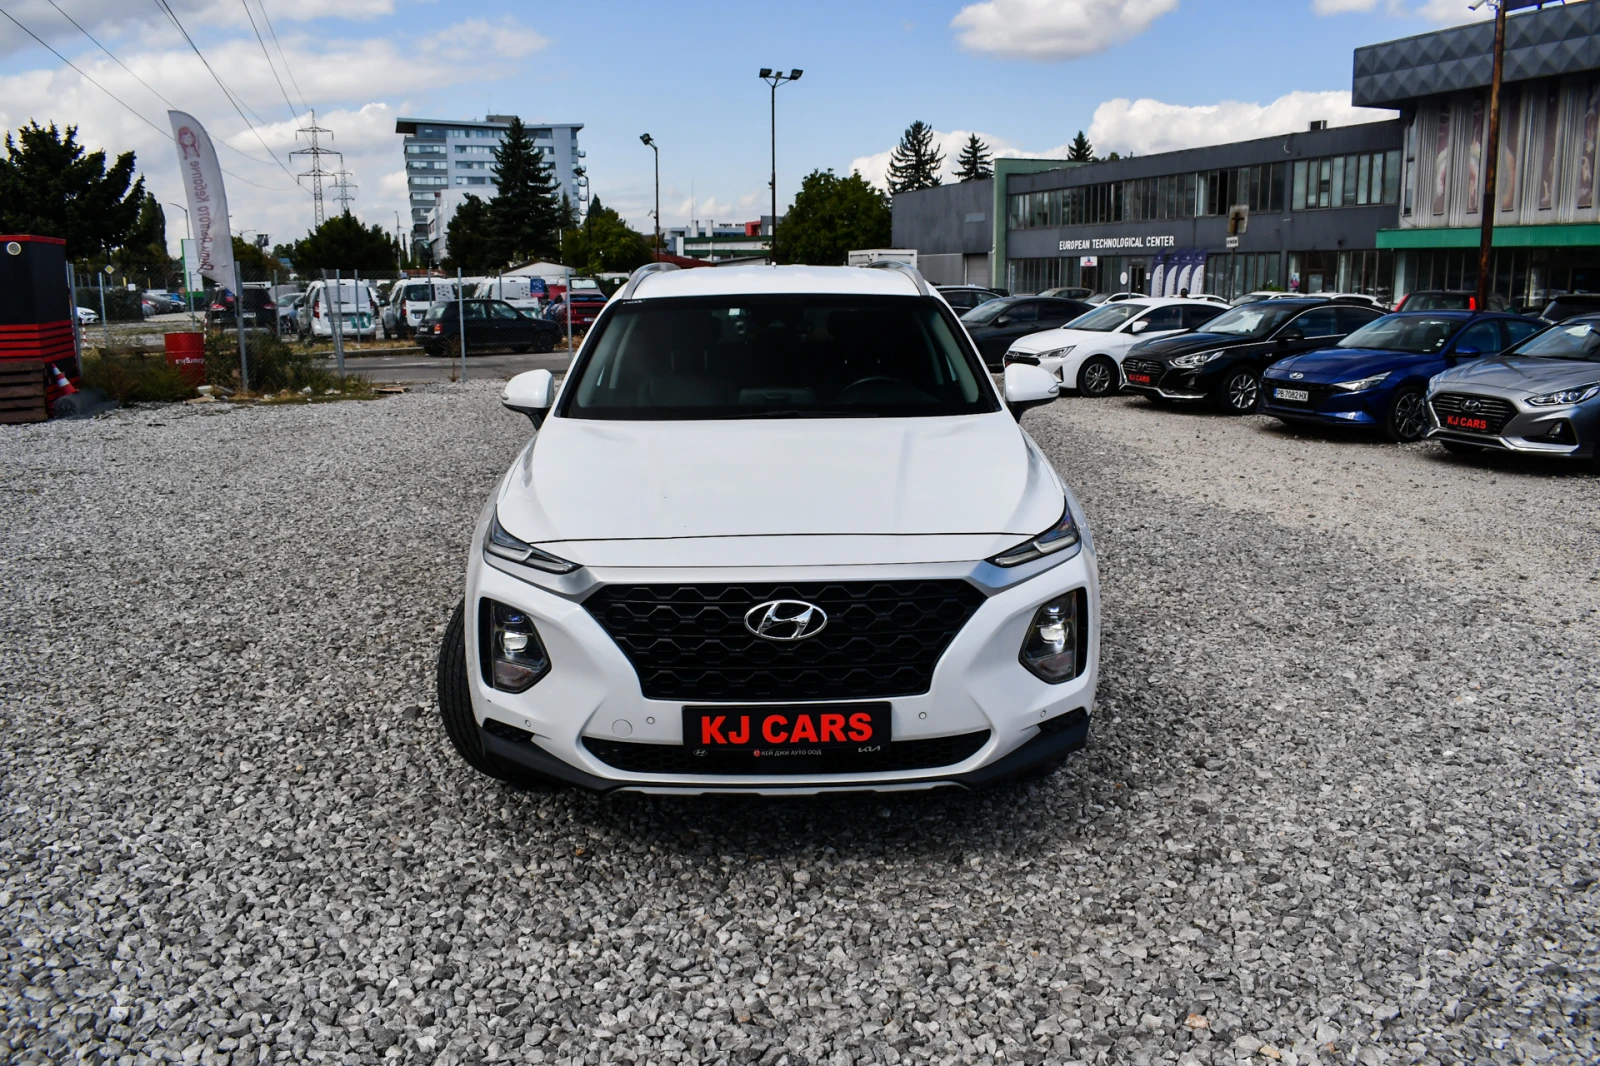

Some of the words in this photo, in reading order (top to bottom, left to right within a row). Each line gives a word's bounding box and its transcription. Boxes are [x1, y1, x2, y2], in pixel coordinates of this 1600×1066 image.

[1059, 239, 1090, 251] EUROPEAN
[1092, 237, 1143, 249] TECHNOLOGICAL
[1146, 235, 1175, 247] CENTER
[1447, 415, 1458, 425] KJ
[1460, 417, 1487, 429] CARS
[701, 715, 750, 745] KJ
[762, 712, 873, 744] CARS
[774, 749, 790, 757] ДЖИ
